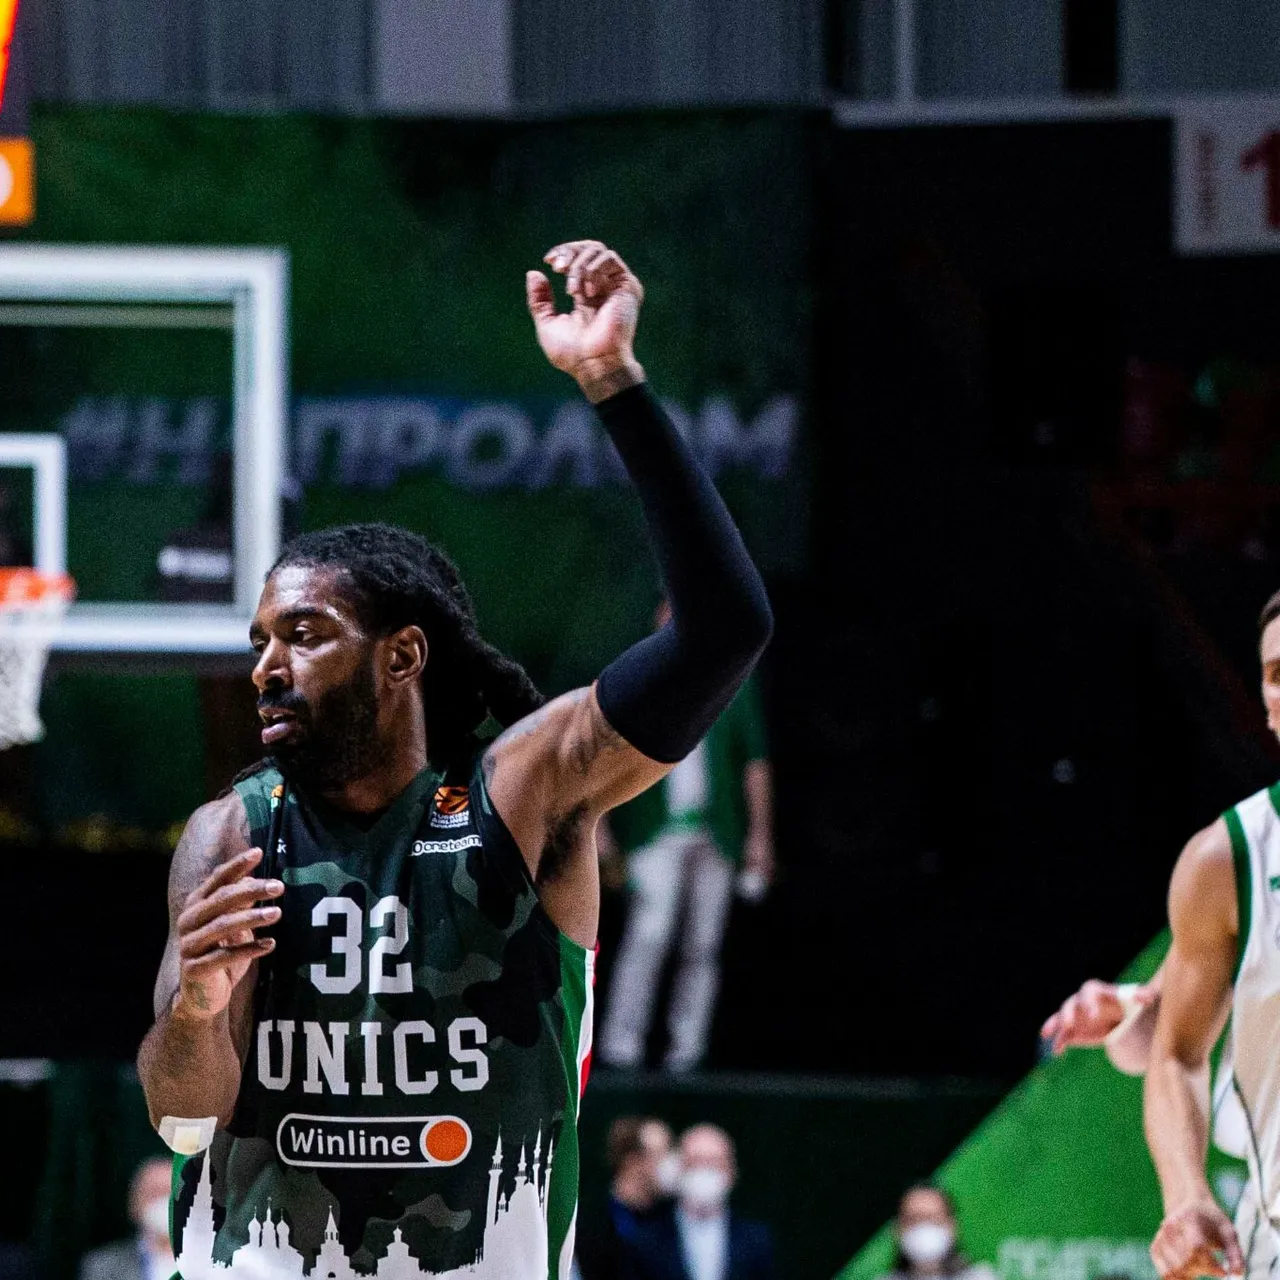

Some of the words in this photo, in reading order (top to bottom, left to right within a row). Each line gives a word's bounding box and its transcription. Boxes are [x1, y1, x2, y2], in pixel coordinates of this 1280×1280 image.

[310, 895, 414, 995] 32
[257, 1016, 490, 1096] UNICS
[290, 1127, 411, 1157] Winline
